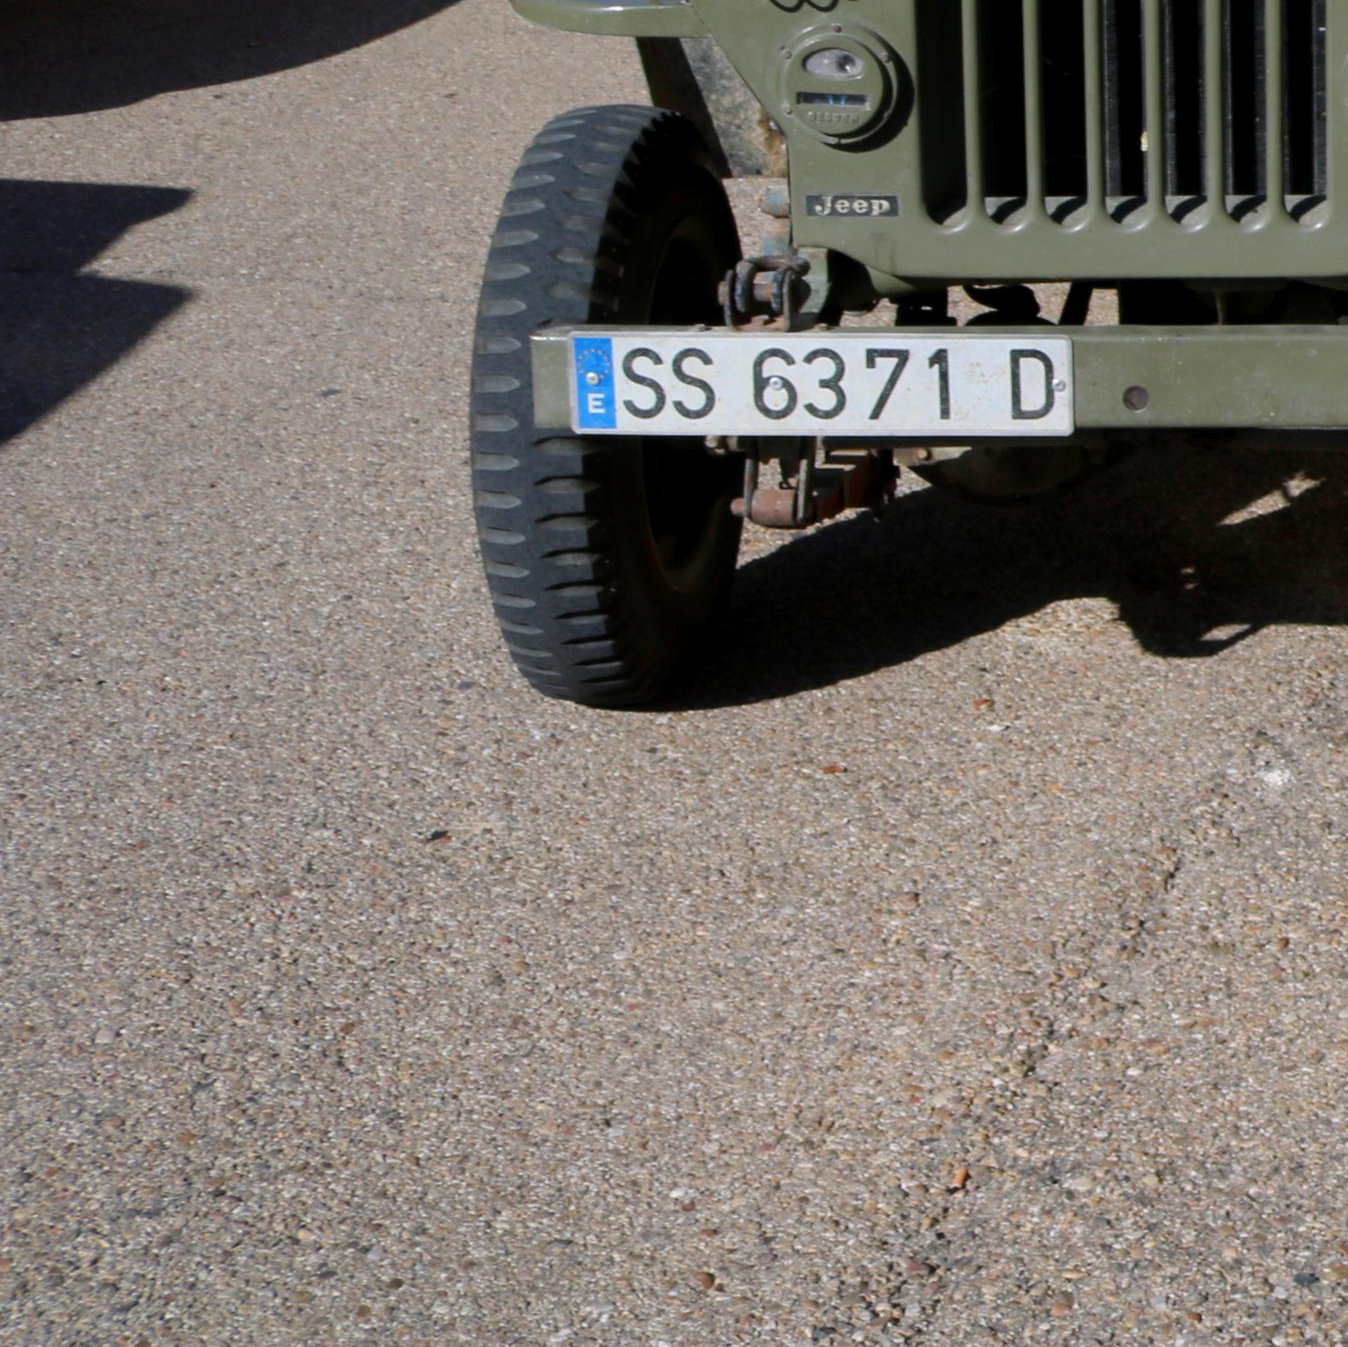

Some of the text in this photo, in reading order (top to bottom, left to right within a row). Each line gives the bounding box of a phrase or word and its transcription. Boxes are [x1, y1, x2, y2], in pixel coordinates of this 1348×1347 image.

[813, 195, 891, 217] Jeep
[622, 347, 1055, 421] SS 6371 D
[587, 393, 605, 414] E
